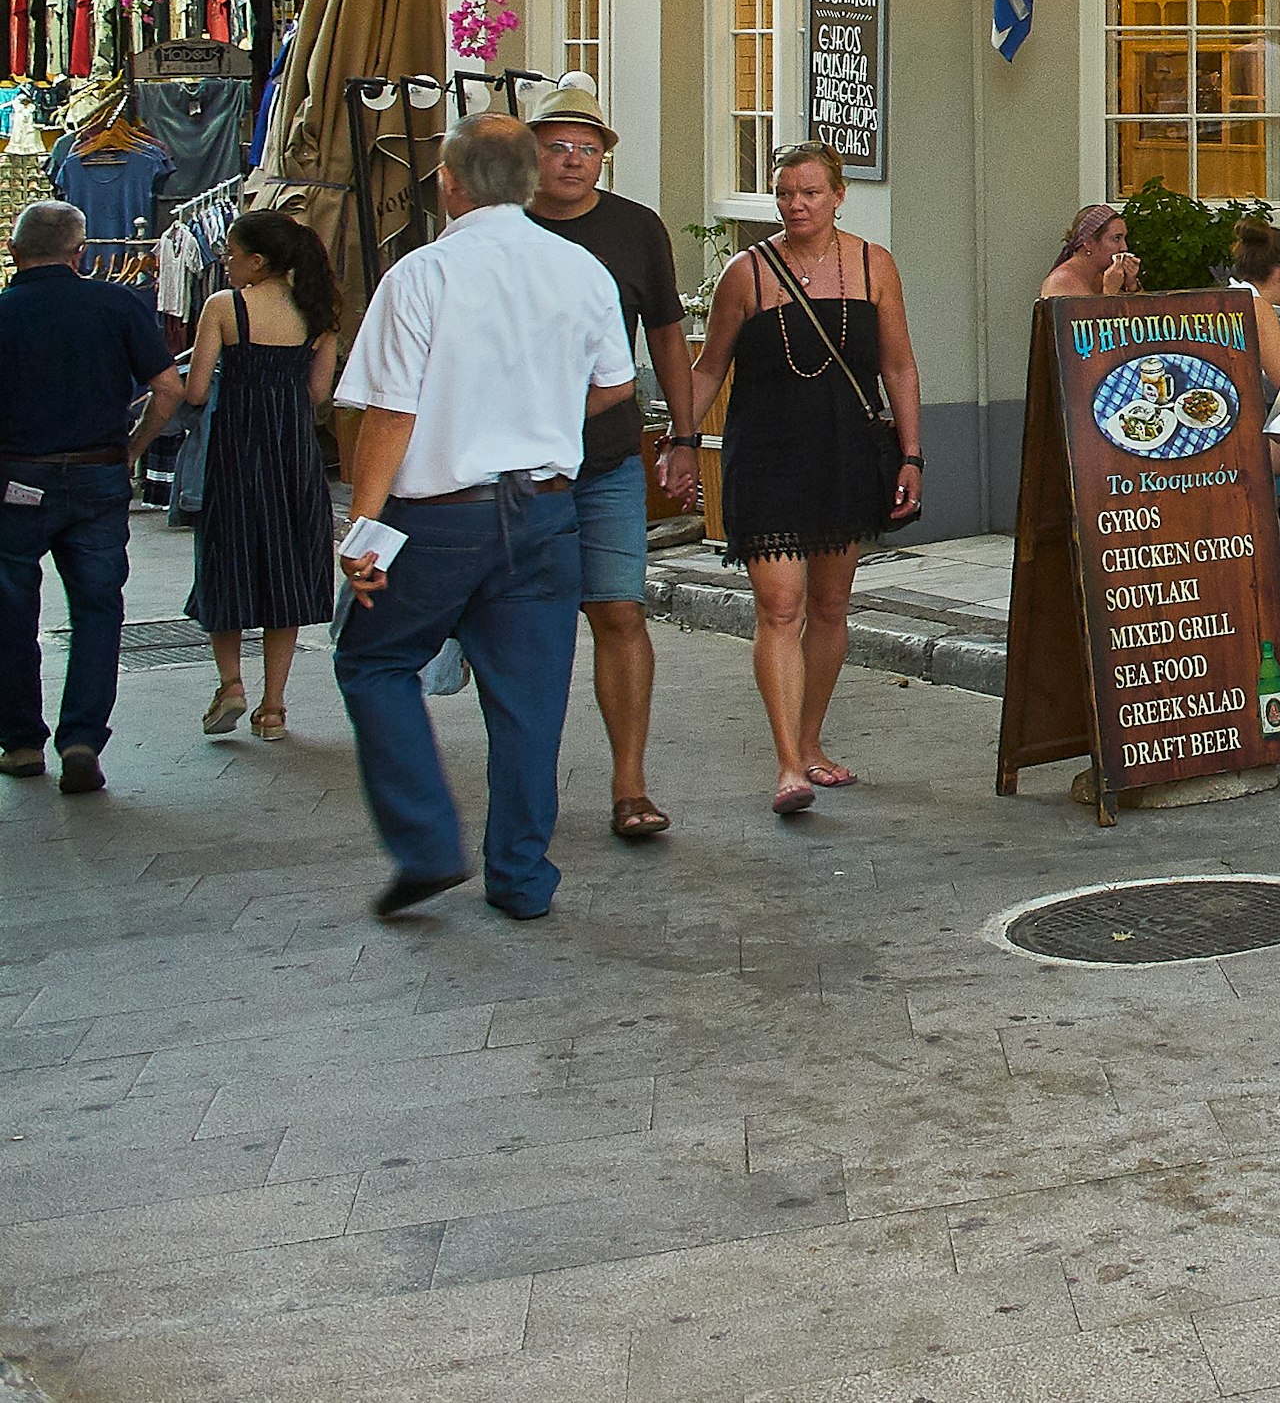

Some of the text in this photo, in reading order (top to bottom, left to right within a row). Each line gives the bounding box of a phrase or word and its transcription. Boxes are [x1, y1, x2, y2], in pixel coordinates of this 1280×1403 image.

[818, 24, 861, 51] GYROS
[813, 52, 867, 84] MOUSAKA
[816, 76, 873, 108] BURGERS
[813, 99, 842, 125] LAMB
[818, 125, 870, 156] STEAKS
[1107, 464, 1239, 495] Το Κοσμικόν
[1098, 506, 1161, 534] GYROS
[1102, 534, 1254, 573] CHICKEN GYROS
[1105, 578, 1200, 612] SOUVLAKI
[1110, 613, 1235, 651] MIXED GRILL
[1118, 687, 1246, 728] GREEK SALAD
[1122, 726, 1242, 768] DRAFT BEER
